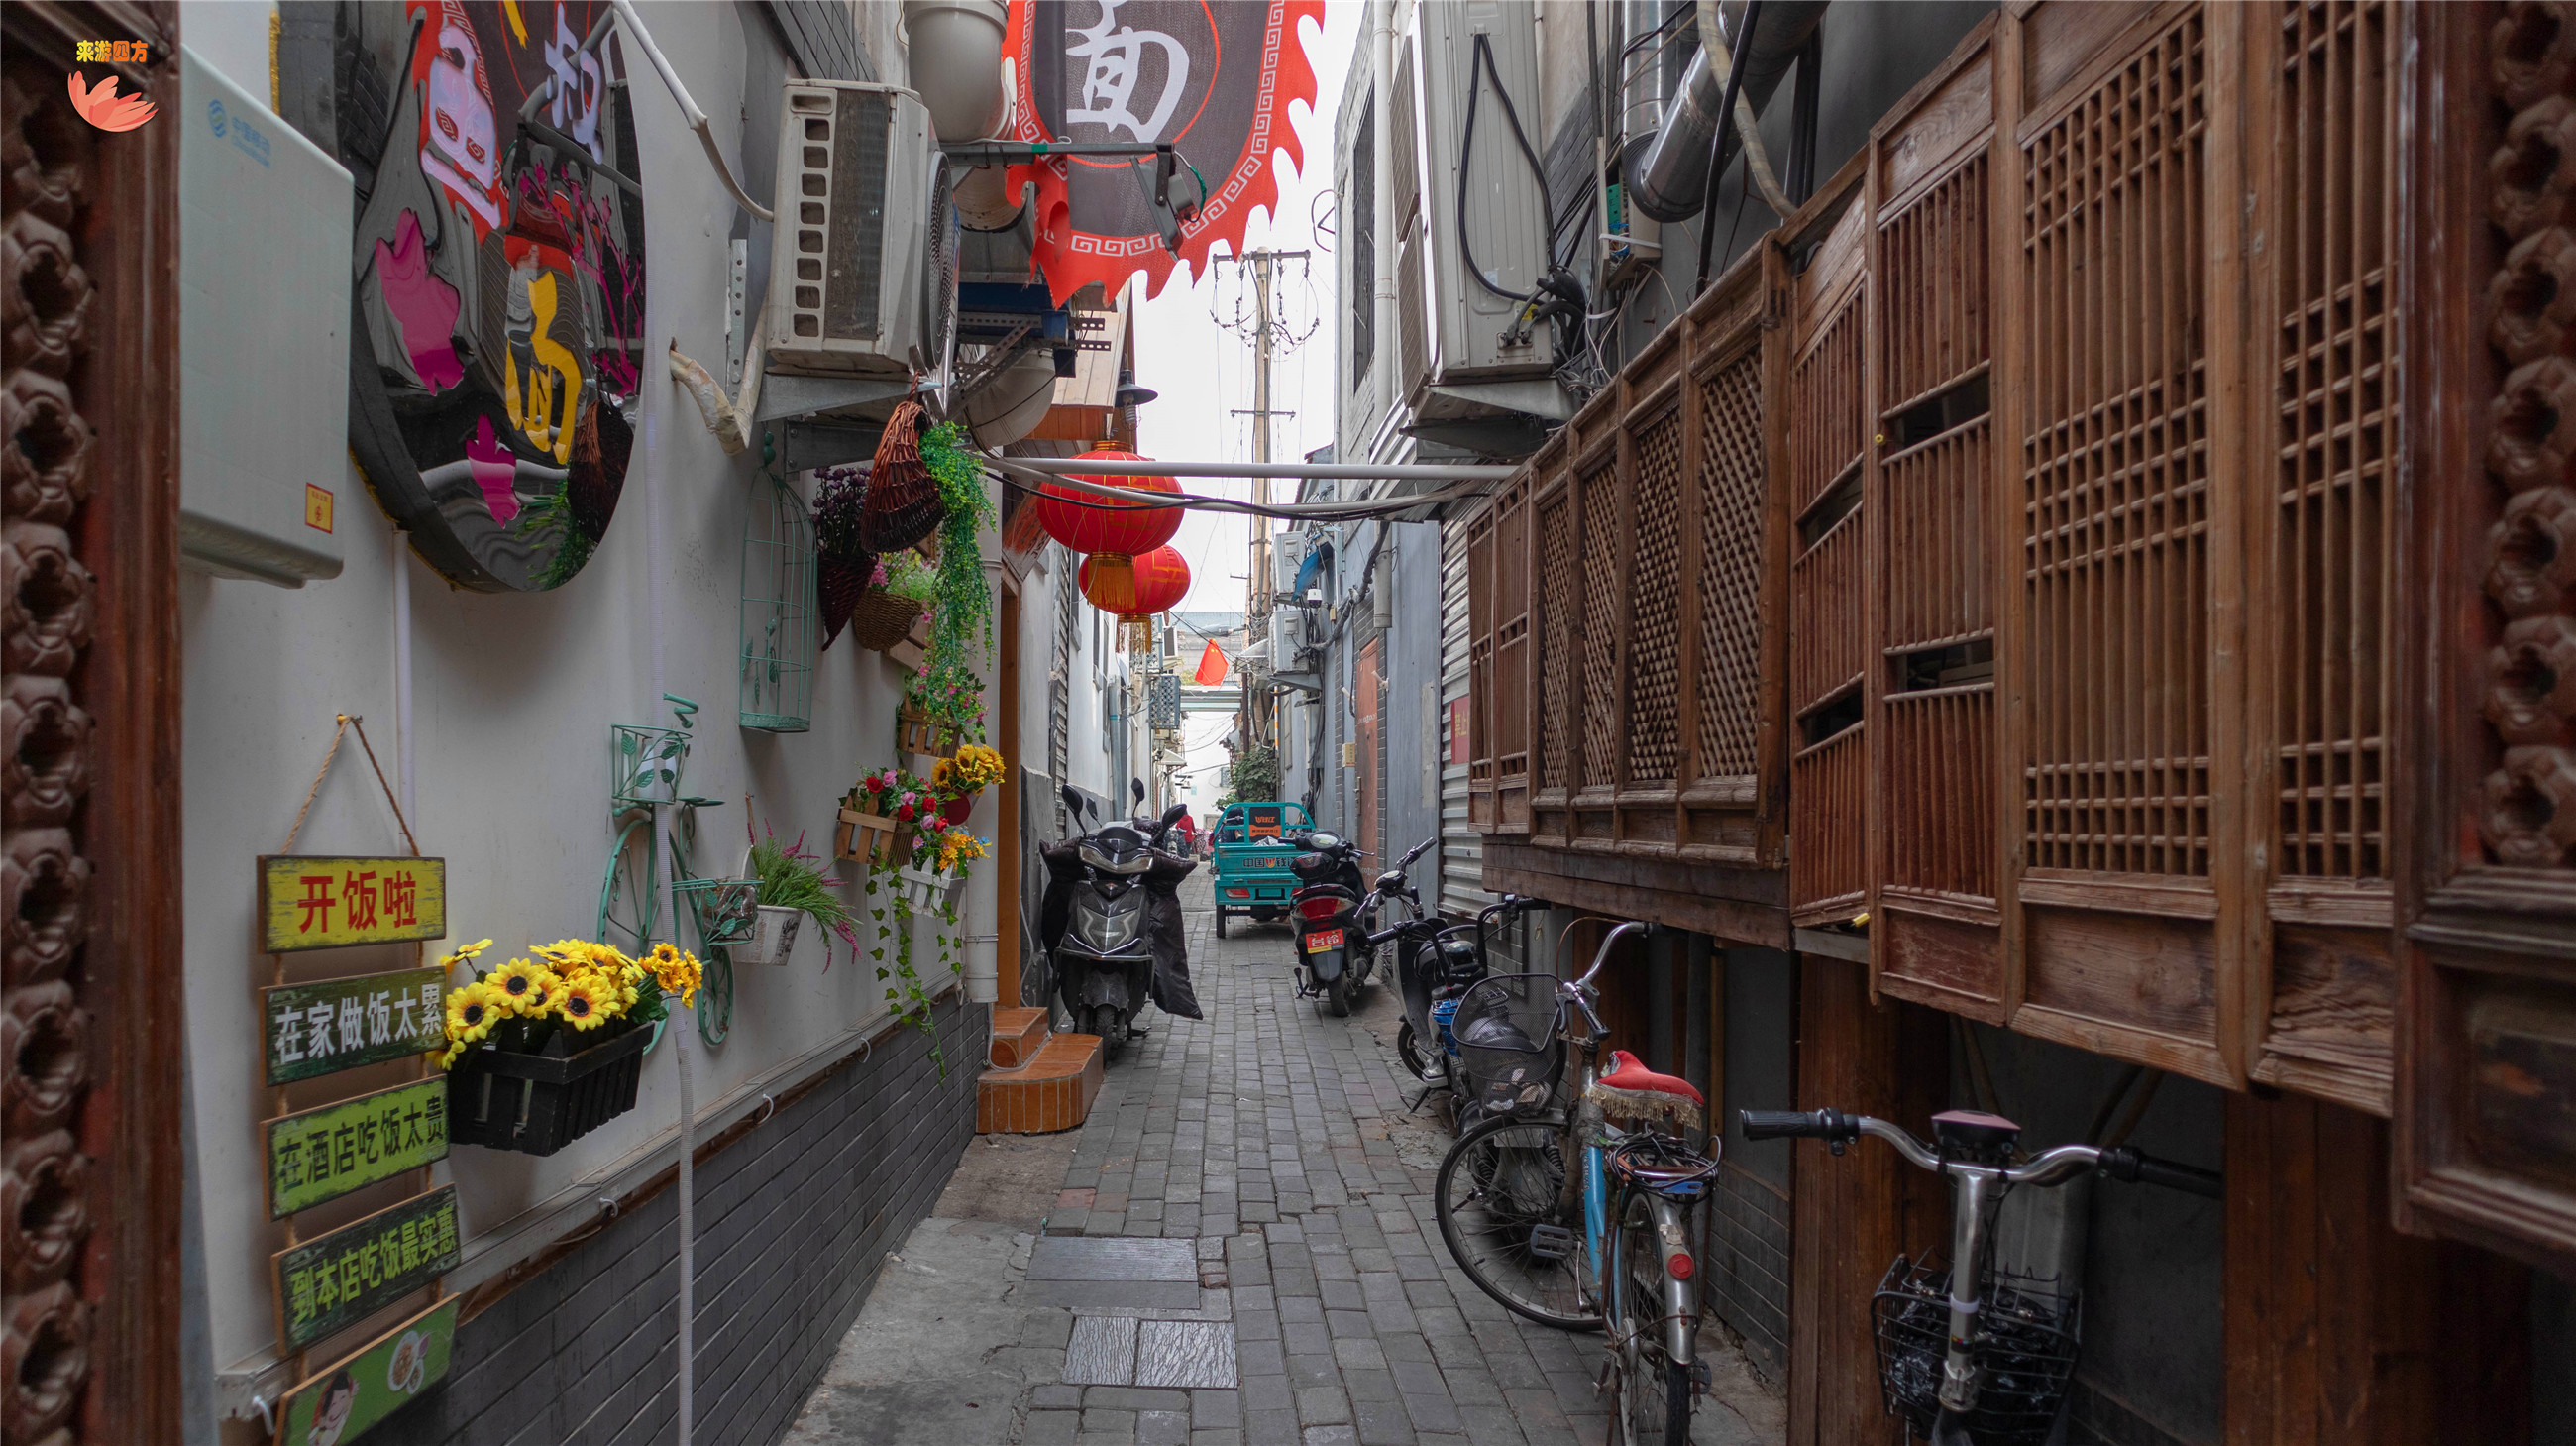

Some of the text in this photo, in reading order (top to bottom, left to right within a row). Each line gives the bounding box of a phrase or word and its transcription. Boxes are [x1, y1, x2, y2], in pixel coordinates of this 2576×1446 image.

[298, 870, 417, 934] 开饭啦
[1312, 934, 1339, 947] 台铃
[274, 984, 442, 1065] 在家做饭太累
[278, 1095, 444, 1183] 在酒店吃饭太贵
[290, 1205, 457, 1323] 到本店吃饭最实惠
